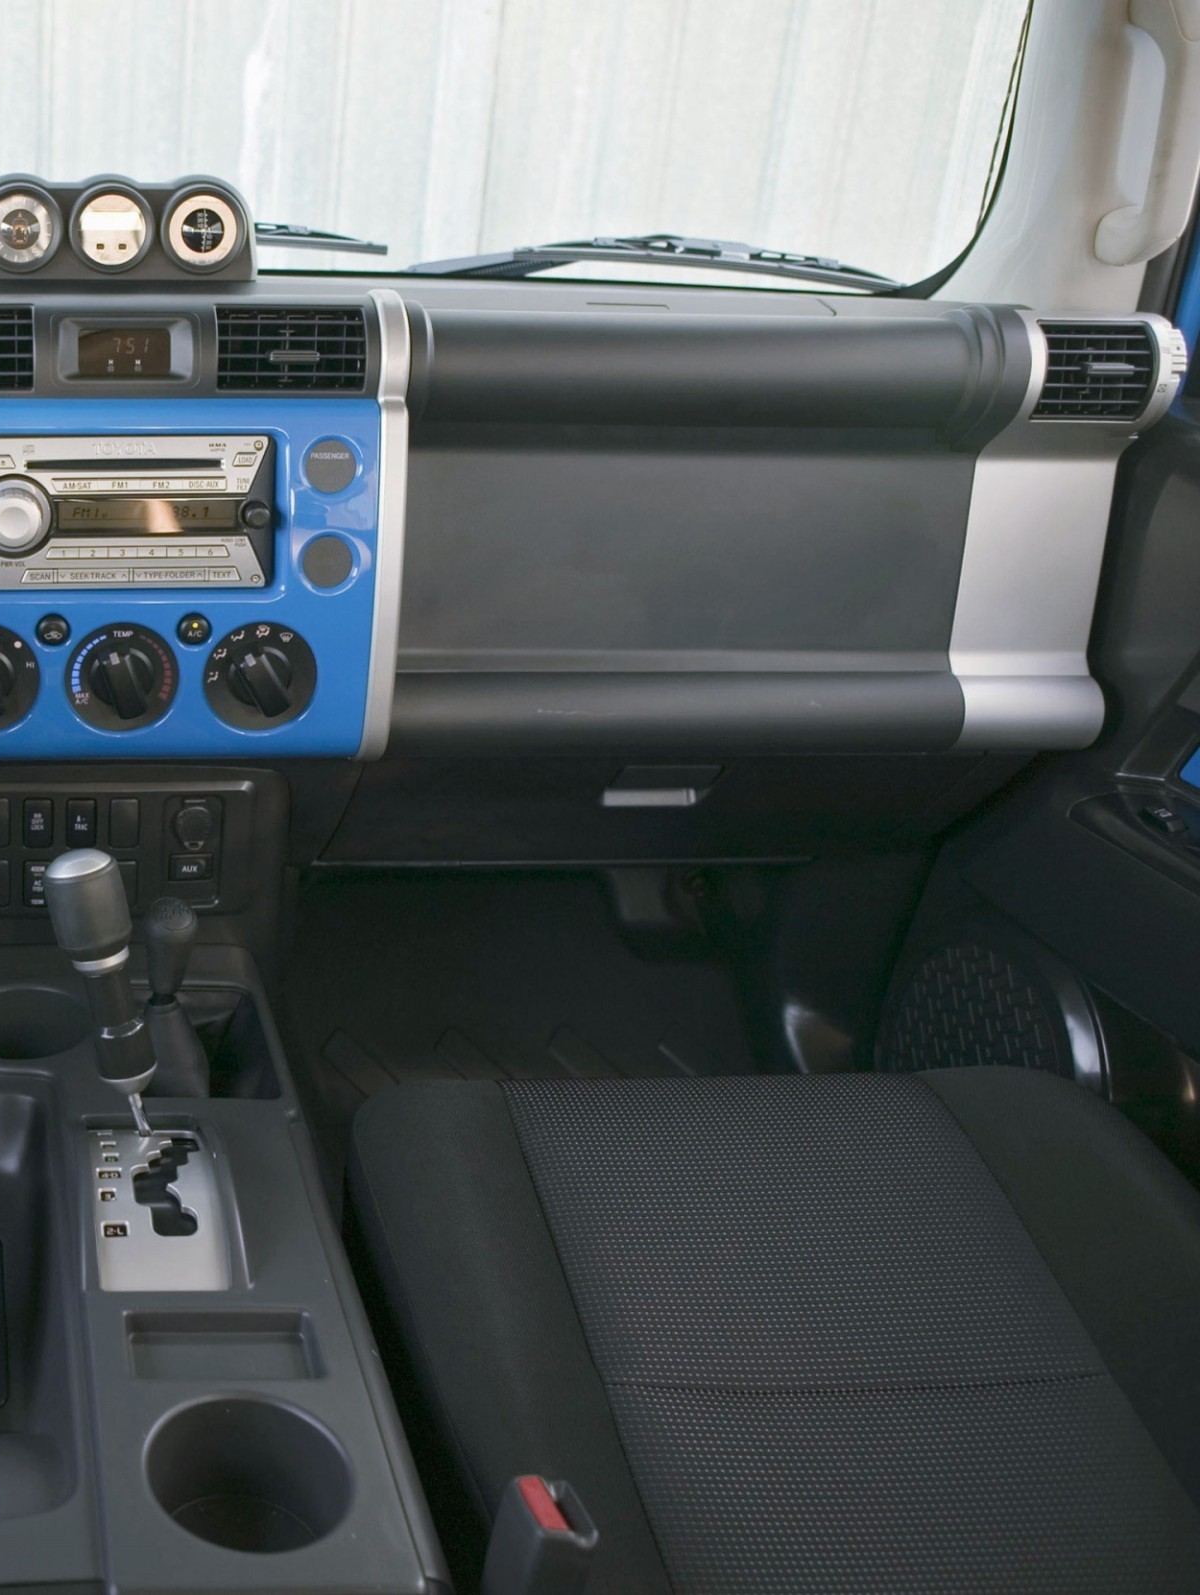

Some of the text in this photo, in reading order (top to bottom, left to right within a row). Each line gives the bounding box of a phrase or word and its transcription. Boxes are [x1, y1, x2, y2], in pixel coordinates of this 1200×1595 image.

[92, 441, 157, 456] TOYOTA
[238, 456, 253, 464] LOAD
[310, 452, 350, 460] PASSENGER
[111, 481, 128, 489] FM1
[152, 481, 170, 489] FM2
[29, 573, 51, 581] SCAN
[212, 571, 231, 579] TEXT
[112, 630, 134, 638] TEMP
[187, 630, 202, 638] A/C
[25, 661, 35, 669] HI
[74, 823, 88, 831] TRAC
[181, 864, 198, 873] AUX
